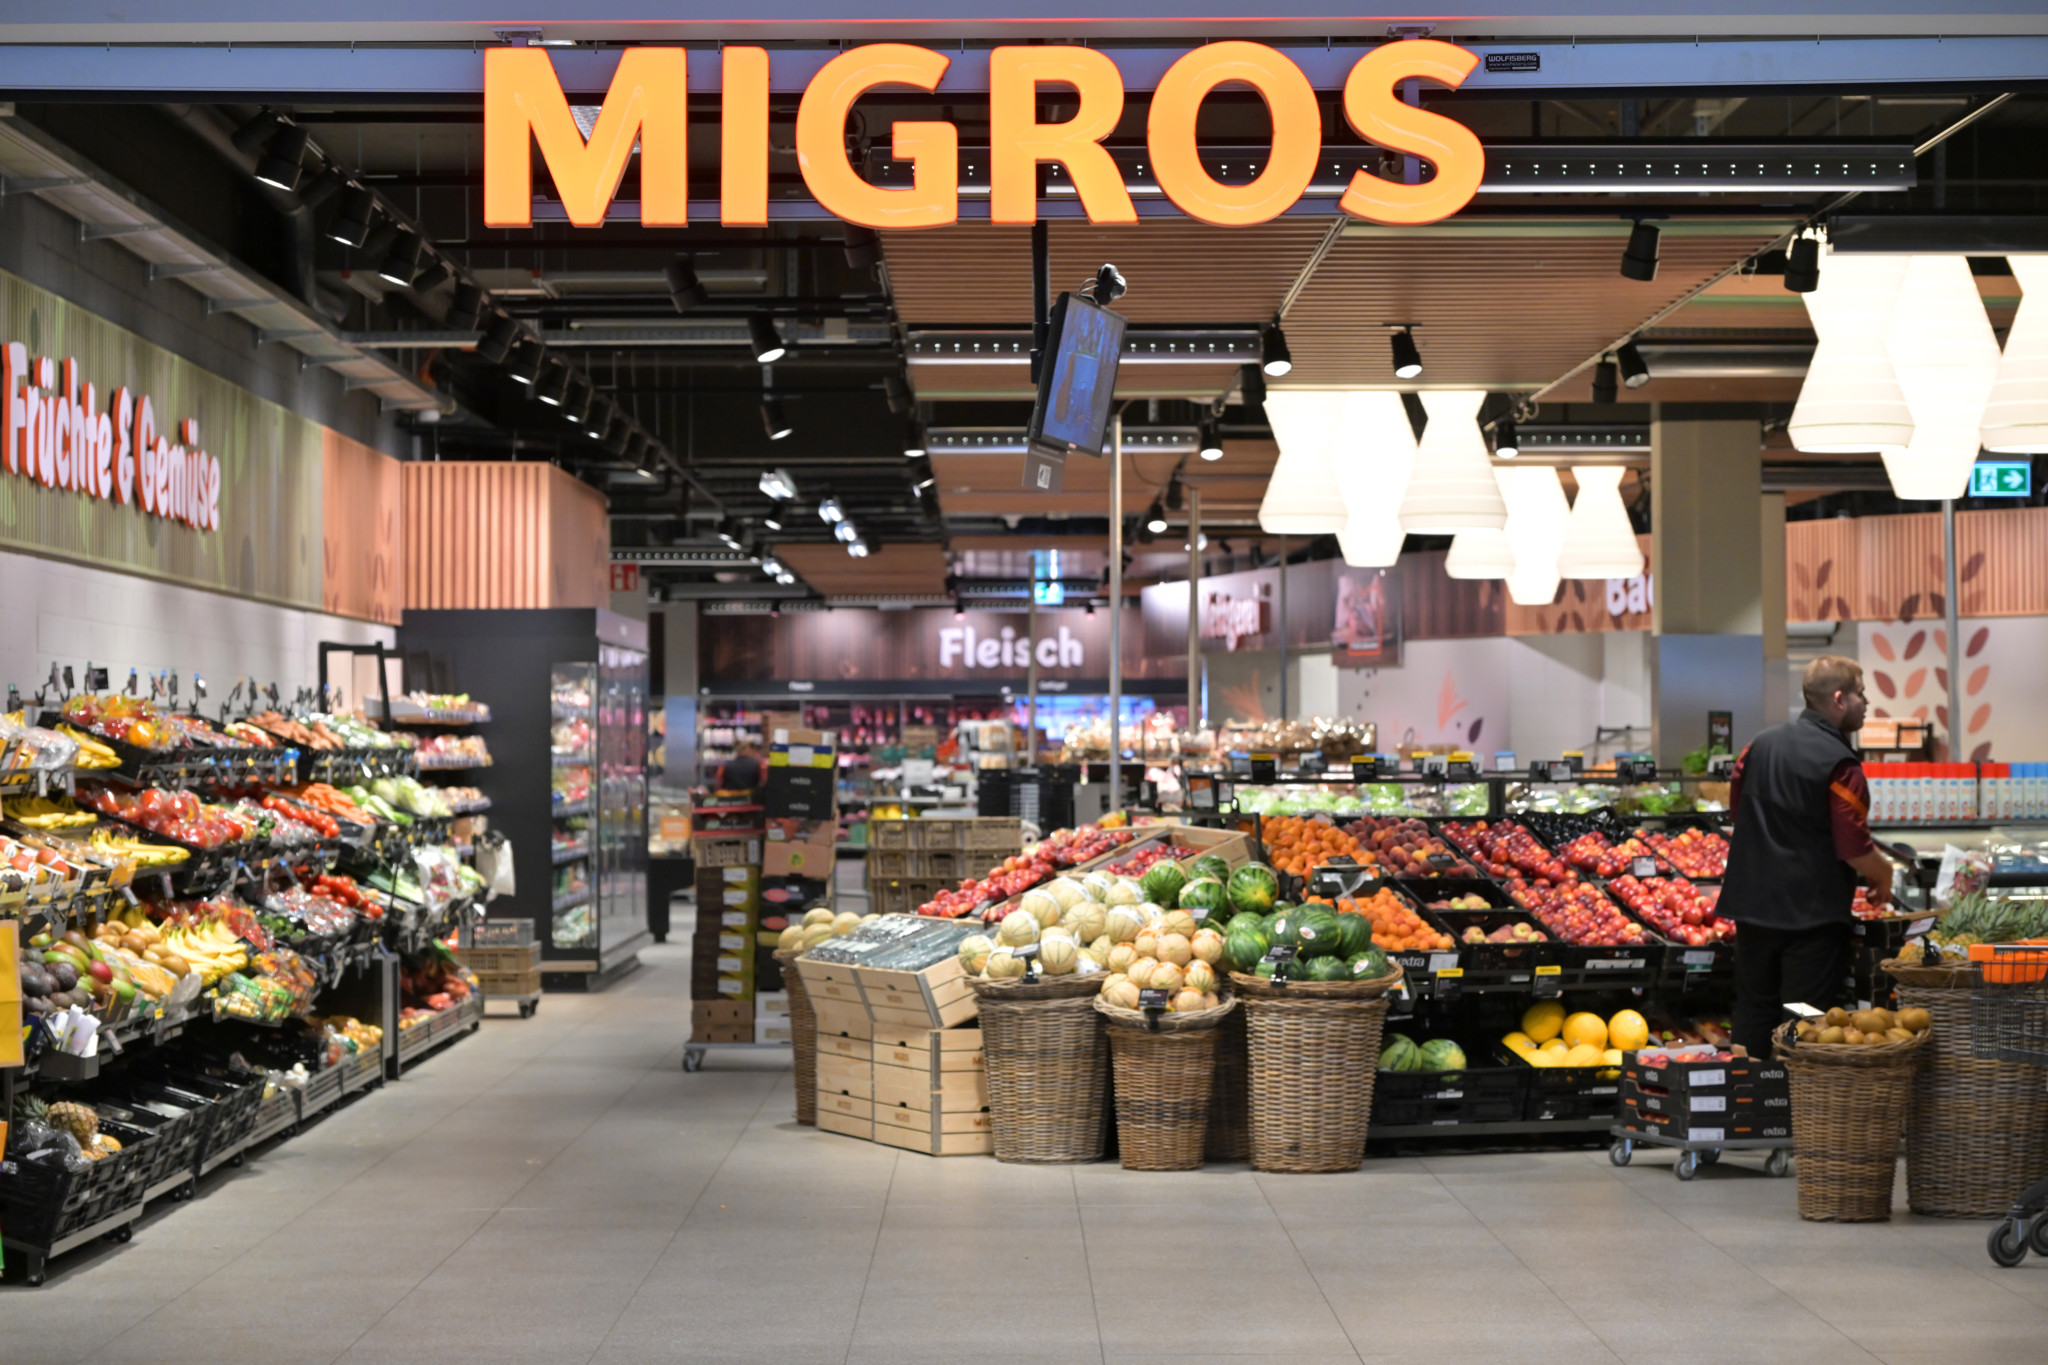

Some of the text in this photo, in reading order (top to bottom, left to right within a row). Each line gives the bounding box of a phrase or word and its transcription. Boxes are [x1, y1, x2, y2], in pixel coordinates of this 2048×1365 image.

[484, 39, 1486, 230] MIGROS
[2, 341, 220, 532] Früchte & Gemüse
[939, 625, 1084, 668] Fleisch
[1397, 956, 1425, 967] extra
